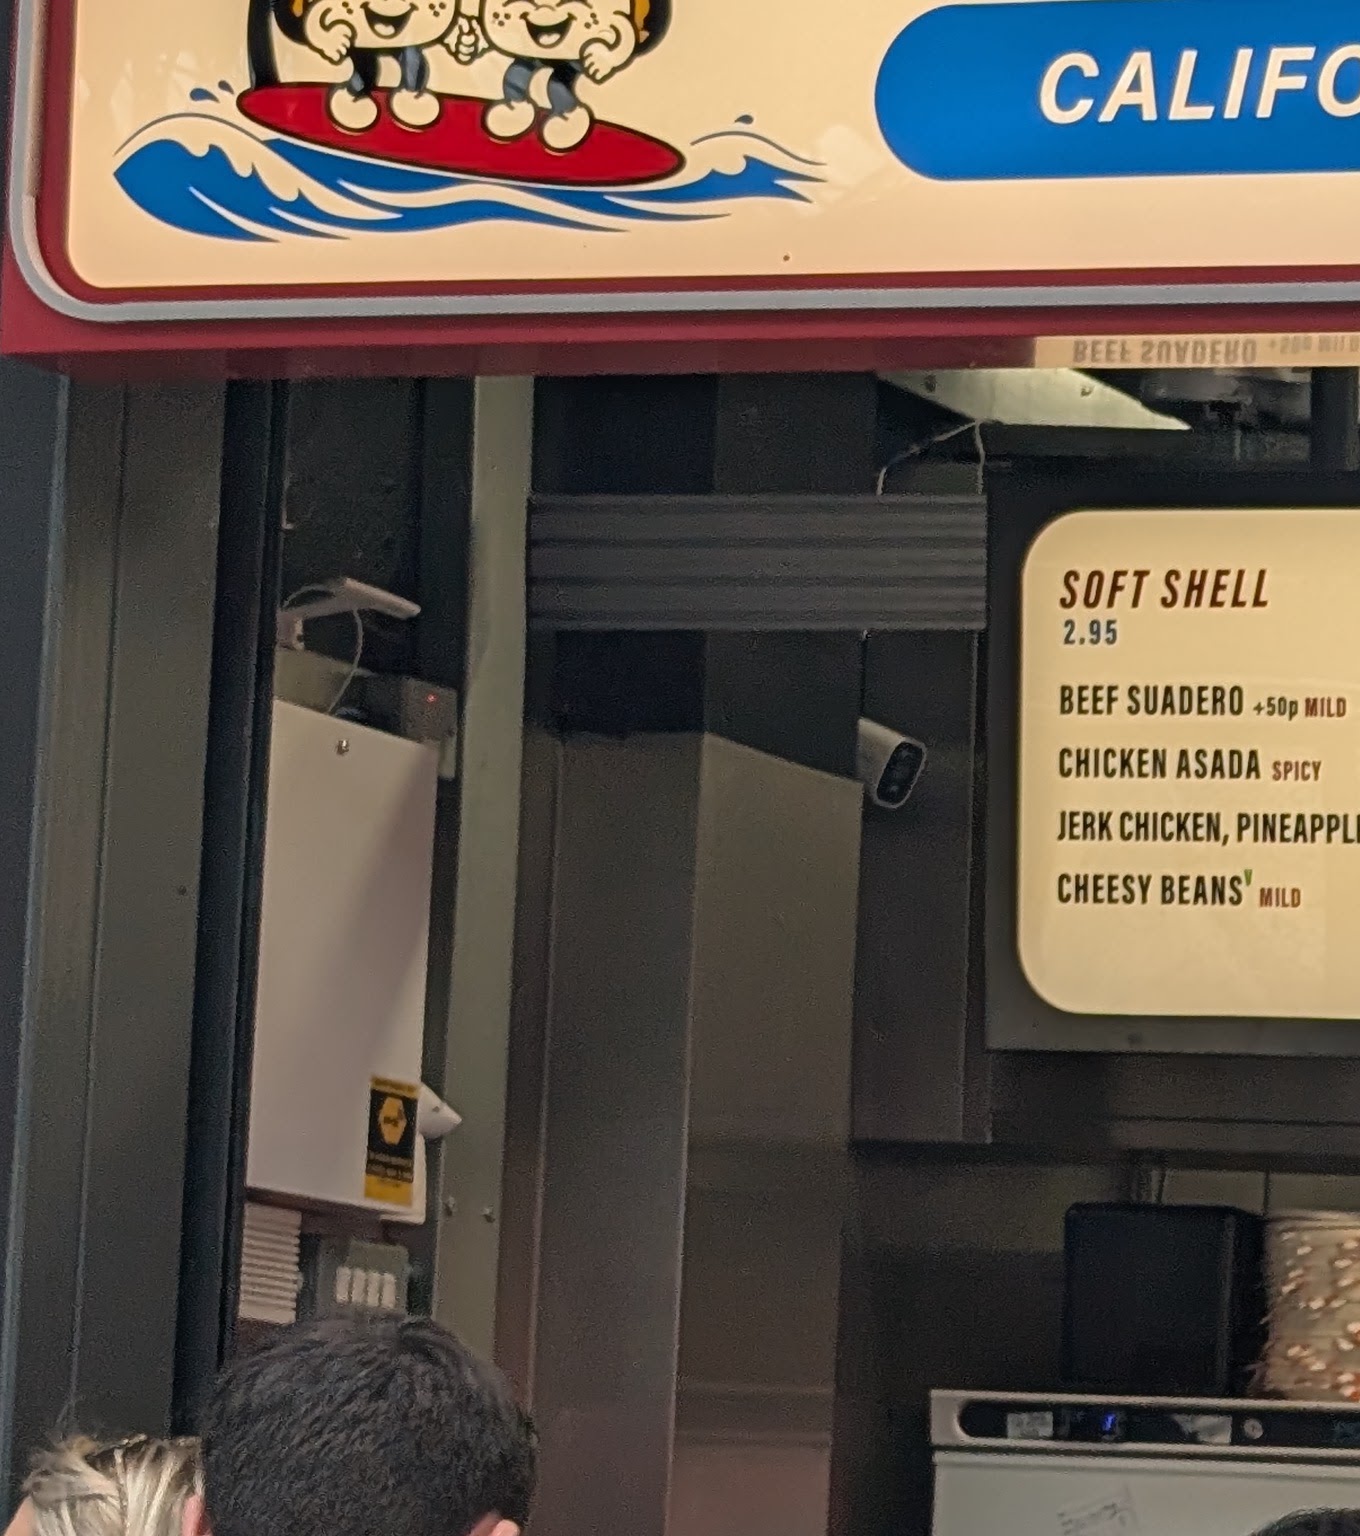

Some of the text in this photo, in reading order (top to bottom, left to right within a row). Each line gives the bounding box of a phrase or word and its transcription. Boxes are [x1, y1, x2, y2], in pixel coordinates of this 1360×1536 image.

[1059, 568, 1268, 610] SOFT SHELL
[1063, 618, 1117, 646] 2.95
[1059, 684, 1119, 715] BEEF
[1127, 684, 1244, 716] SUADERO
[1304, 696, 1347, 718] MILD
[1058, 747, 1322, 782] CHICKEN ASADA SPICY
[1057, 810, 1113, 841] JERK
[1119, 811, 1229, 846] CHICKEN,
[1057, 873, 1152, 905] CHEESY
[1259, 887, 1301, 908] MILD
